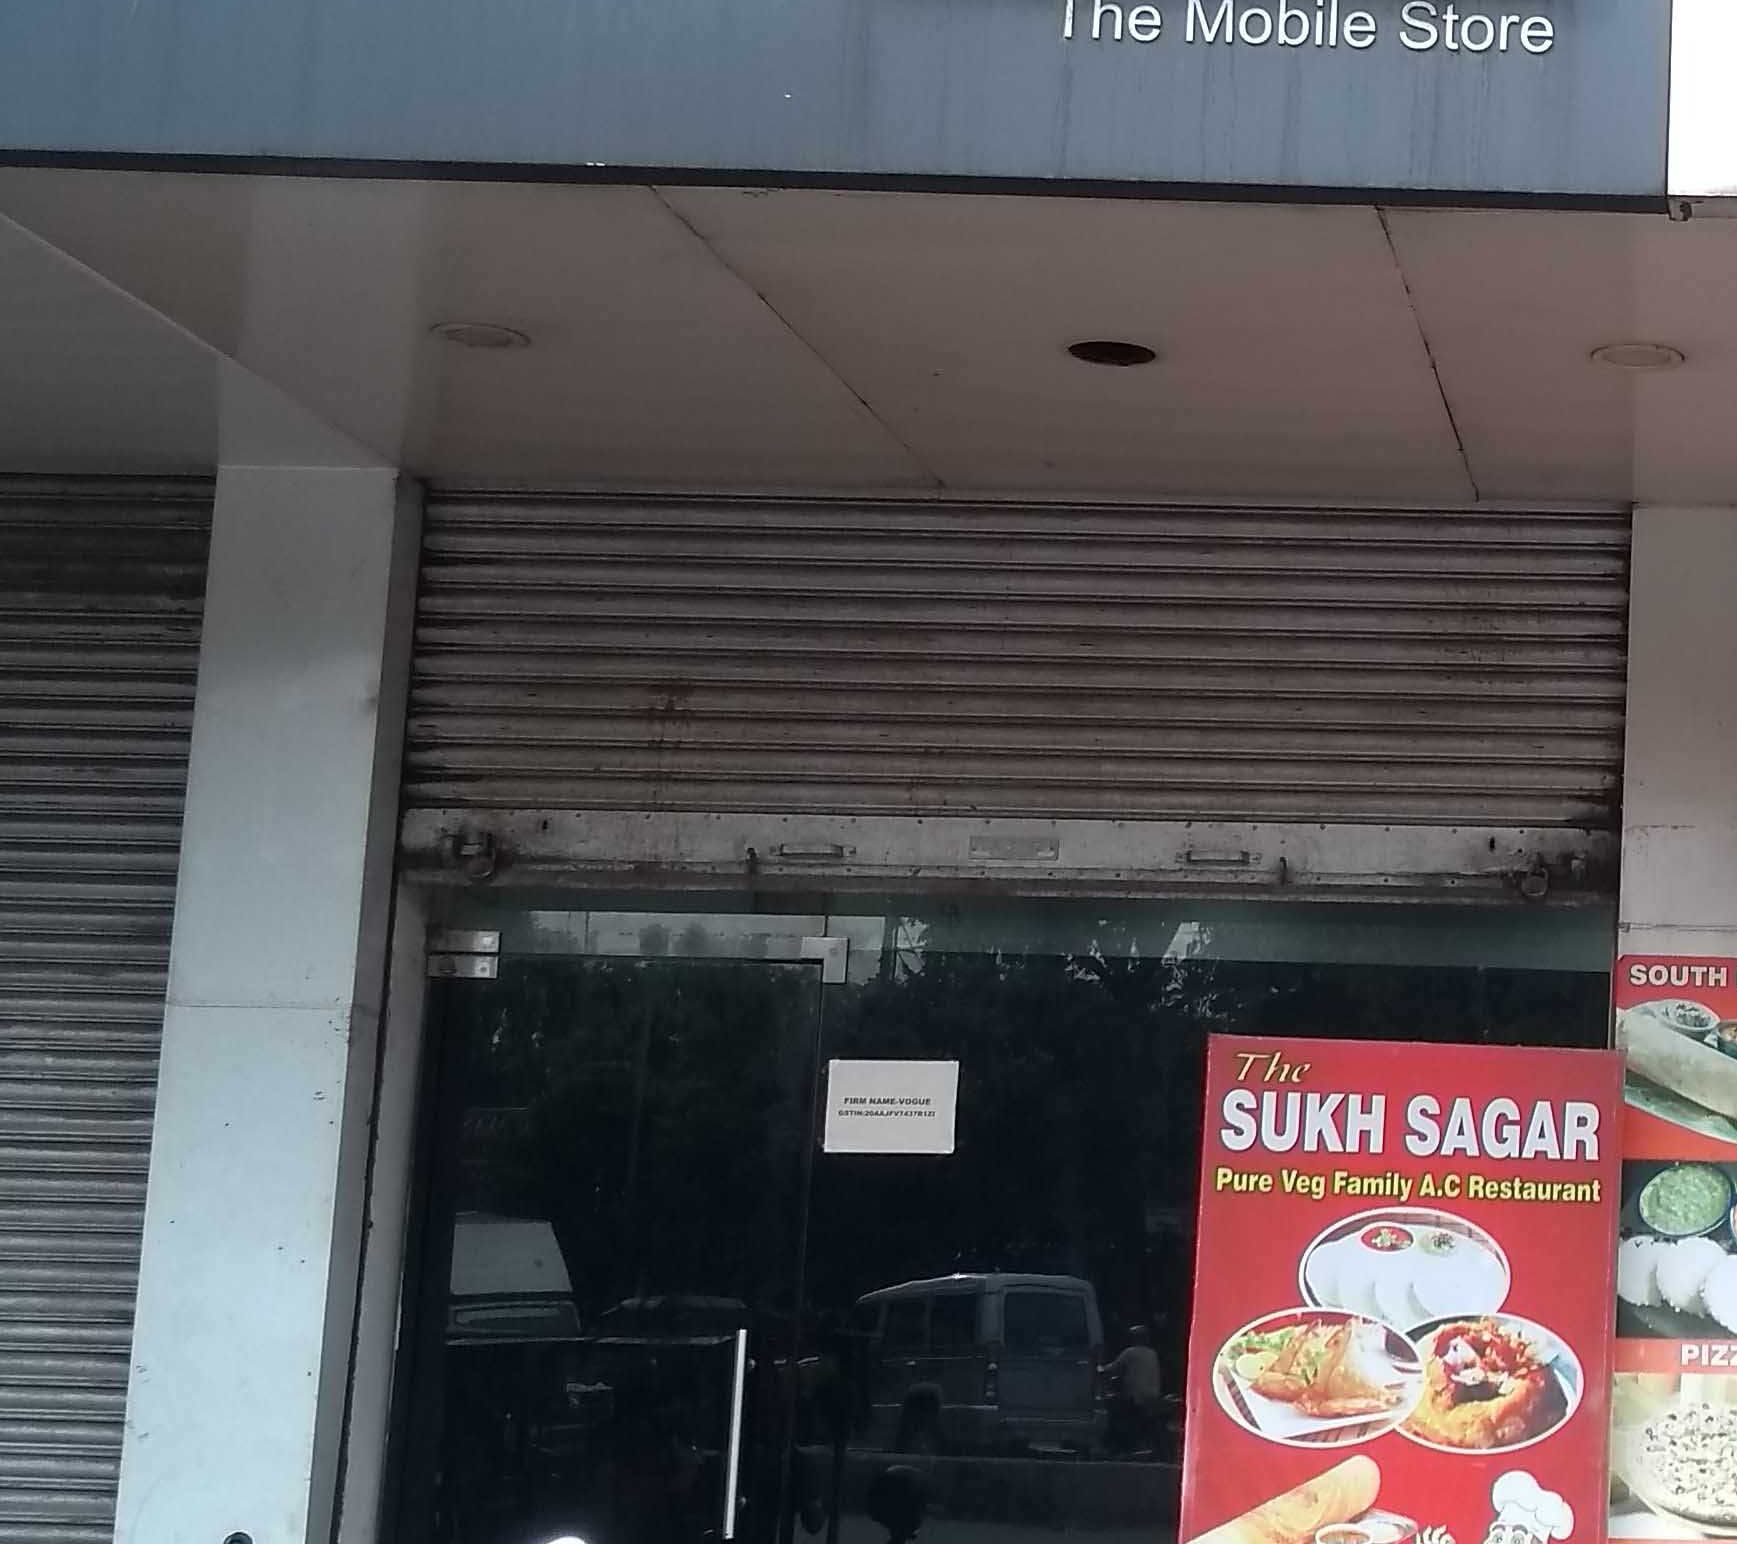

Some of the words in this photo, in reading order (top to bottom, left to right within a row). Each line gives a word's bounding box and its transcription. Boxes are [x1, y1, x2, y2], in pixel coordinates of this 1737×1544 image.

[1629, 964, 1728, 988] SOUTH
[1234, 1051, 1311, 1085] The
[843, 1097, 867, 1105] FIRM
[1218, 1088, 1386, 1155] SUKH
[1404, 1095, 1601, 1162] SAGAR
[1215, 1167, 1274, 1193] Pure
[1280, 1169, 1326, 1200] Veg
[1333, 1171, 1413, 1201] Family
[1418, 1173, 1461, 1199] A.C
[1467, 1175, 1601, 1203] Restaurant
